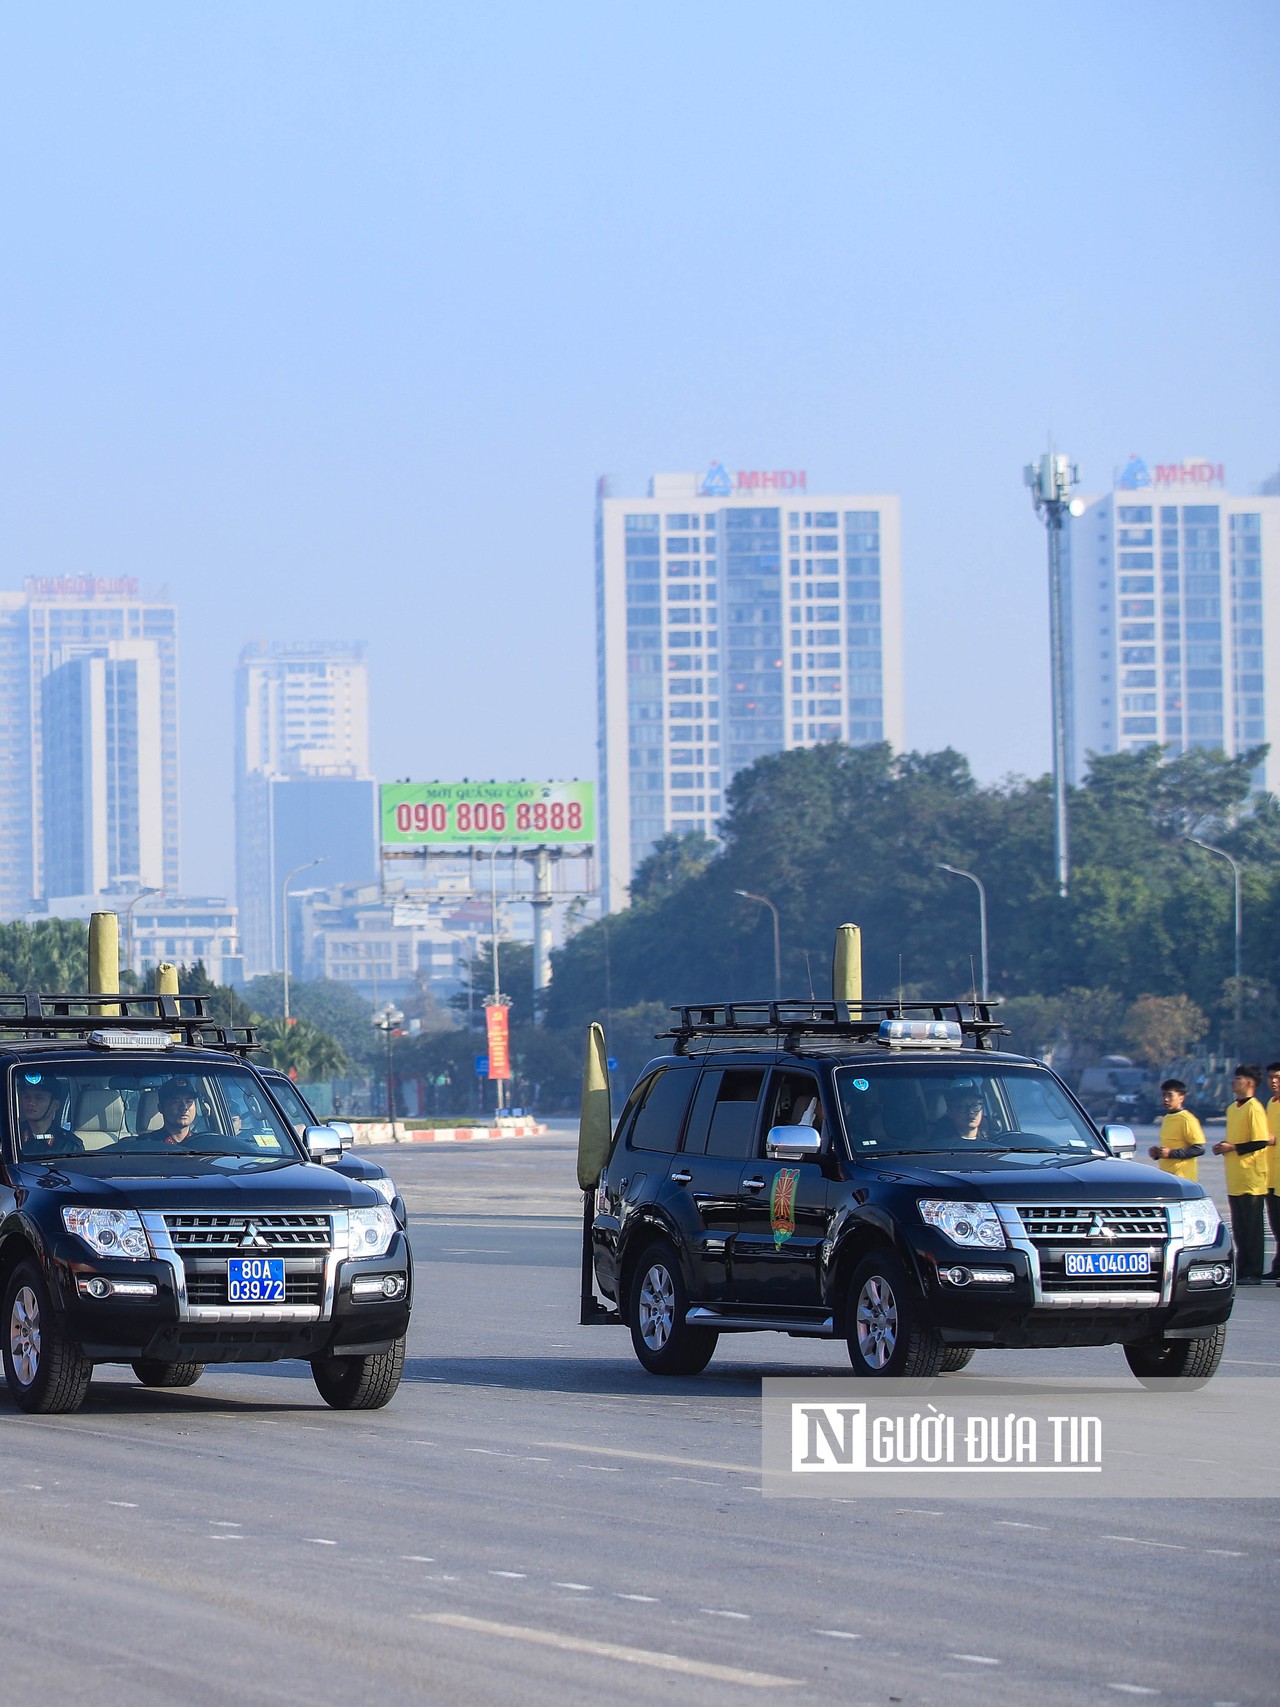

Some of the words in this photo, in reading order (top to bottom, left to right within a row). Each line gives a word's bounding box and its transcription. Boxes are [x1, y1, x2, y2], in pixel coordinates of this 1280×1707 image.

[738, 470, 806, 489] MHDI
[1156, 464, 1224, 482] MHDI
[397, 803, 447, 832] 090
[456, 803, 506, 832] 806
[516, 802, 583, 831] 8888
[241, 1260, 272, 1279] 80A
[1068, 1253, 1148, 1273] 80A-040.08
[230, 1280, 284, 1300] 039.72
